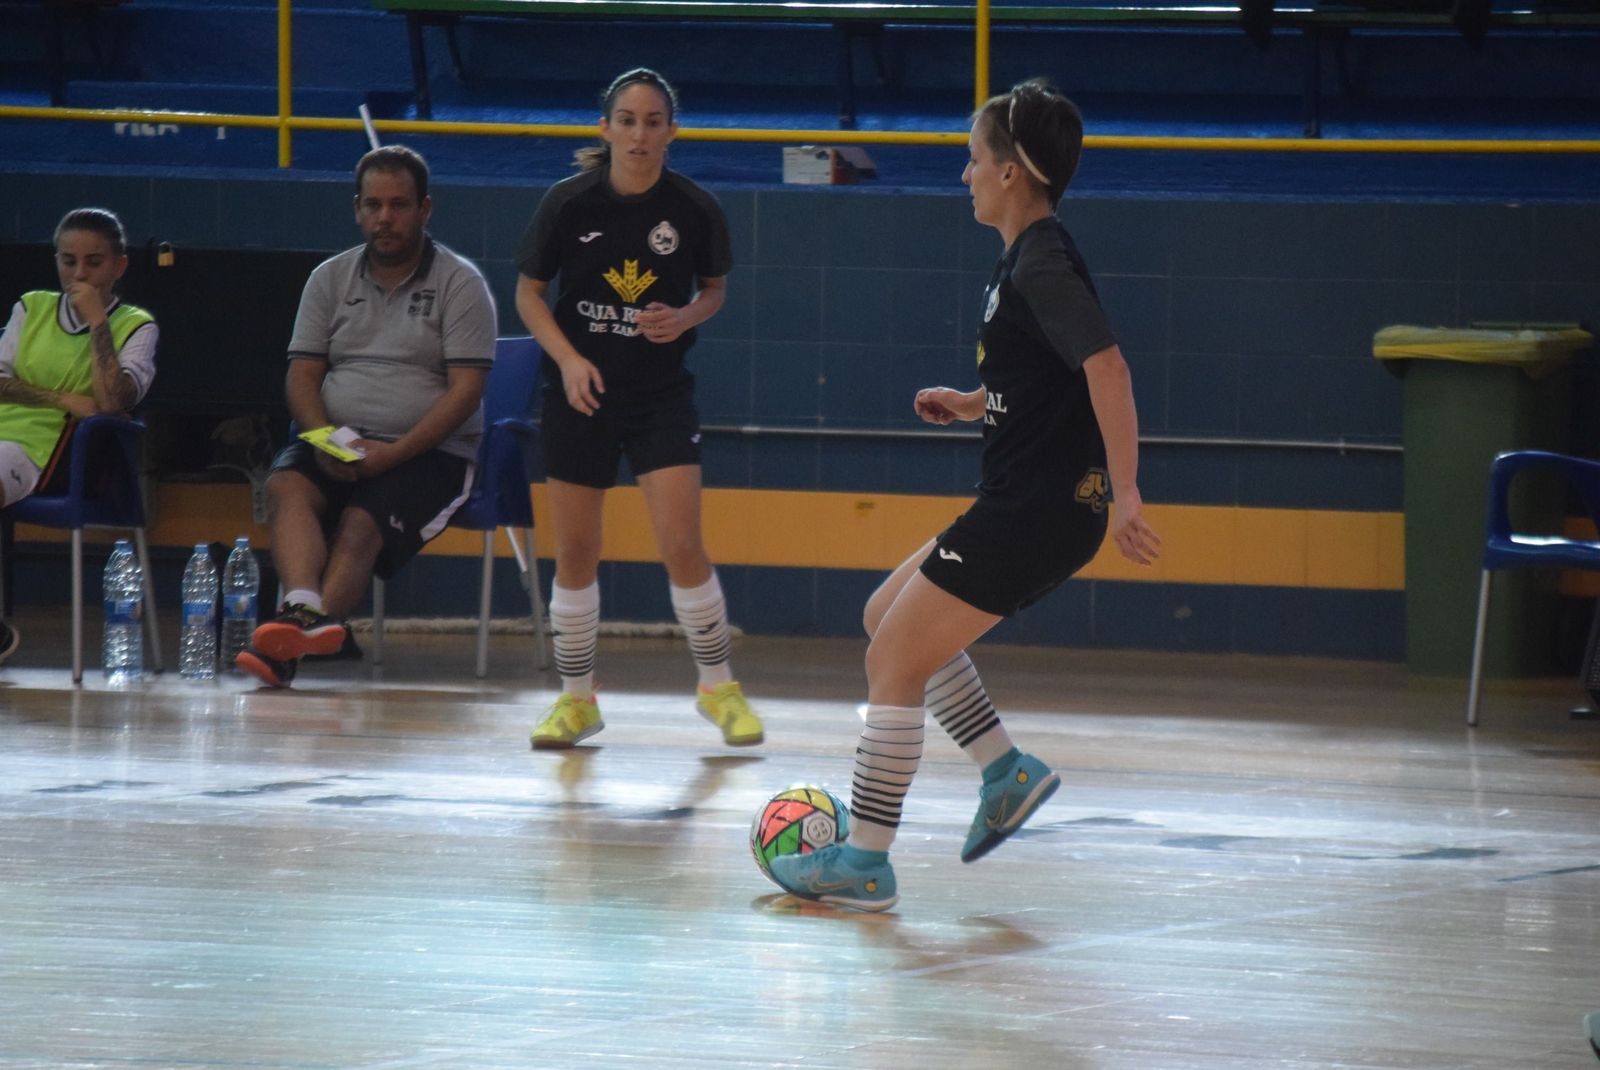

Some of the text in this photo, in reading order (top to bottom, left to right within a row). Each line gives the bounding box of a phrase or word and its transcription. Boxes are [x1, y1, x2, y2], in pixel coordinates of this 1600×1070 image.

[576, 300, 619, 321] CAJA
[589, 322, 637, 337] DE ZAM
[984, 389, 1007, 413] AL
